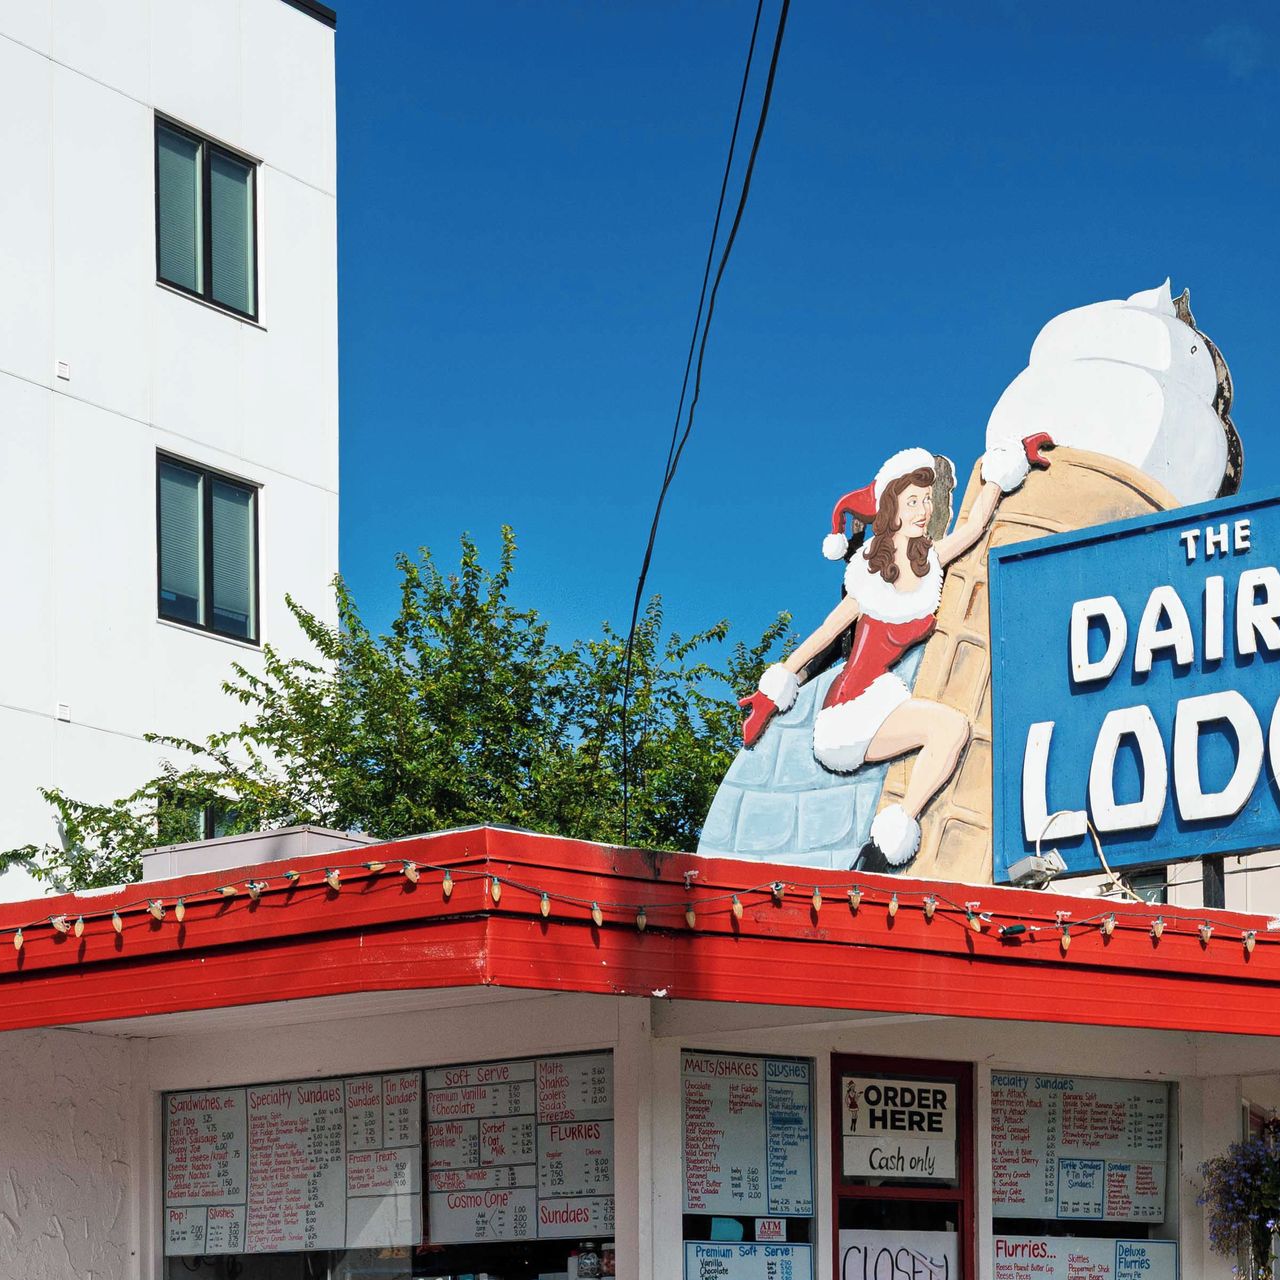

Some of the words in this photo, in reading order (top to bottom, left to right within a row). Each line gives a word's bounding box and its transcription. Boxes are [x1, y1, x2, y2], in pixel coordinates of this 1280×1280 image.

[1181, 518, 1251, 560] THE
[540, 1062, 563, 1074] Malts
[445, 1069, 471, 1086] Soft
[477, 1066, 509, 1082] Serve
[539, 1075, 569, 1090] Shakes
[347, 1082, 373, 1094] Turtle
[385, 1080, 396, 1093] Tin
[400, 1075, 418, 1089] Roof
[991, 1075, 1028, 1090] pecialty
[1035, 1078, 1074, 1091] Sundaes
[249, 1087, 292, 1110] Specialty
[297, 1084, 340, 1105] Sundaes
[386, 1091, 417, 1106] Sundaes
[429, 1091, 458, 1103] Premium
[461, 1086, 486, 1100] Vanilla
[539, 1090, 566, 1102] Coolers
[864, 1085, 947, 1110] ORDER
[348, 1095, 379, 1108] Sundaes
[540, 1101, 566, 1111] Sodas
[436, 1102, 475, 1115] Chocolate
[539, 1109, 575, 1121] Freezes
[869, 1109, 943, 1132] HERE
[428, 1125, 443, 1137] Dole
[446, 1122, 463, 1139] Whip
[482, 1121, 505, 1135] Sorbet
[349, 1154, 371, 1164] Frozen
[375, 1151, 397, 1162] Treats
[869, 1146, 904, 1172] Cash
[910, 1145, 935, 1175] only
[447, 1194, 482, 1209] Cosmo
[540, 1202, 589, 1224] Sundaes
[760, 1221, 781, 1230] ATM
[696, 1245, 733, 1258] Premium
[739, 1245, 757, 1257] Soft
[764, 1246, 794, 1257] Serve!
[1119, 1245, 1146, 1257] Deluxe
[700, 1259, 723, 1267] Vanilla
[1068, 1254, 1089, 1263] Skittles
[1118, 1258, 1150, 1269] Flurries
[700, 1267, 729, 1276] Chocolate
